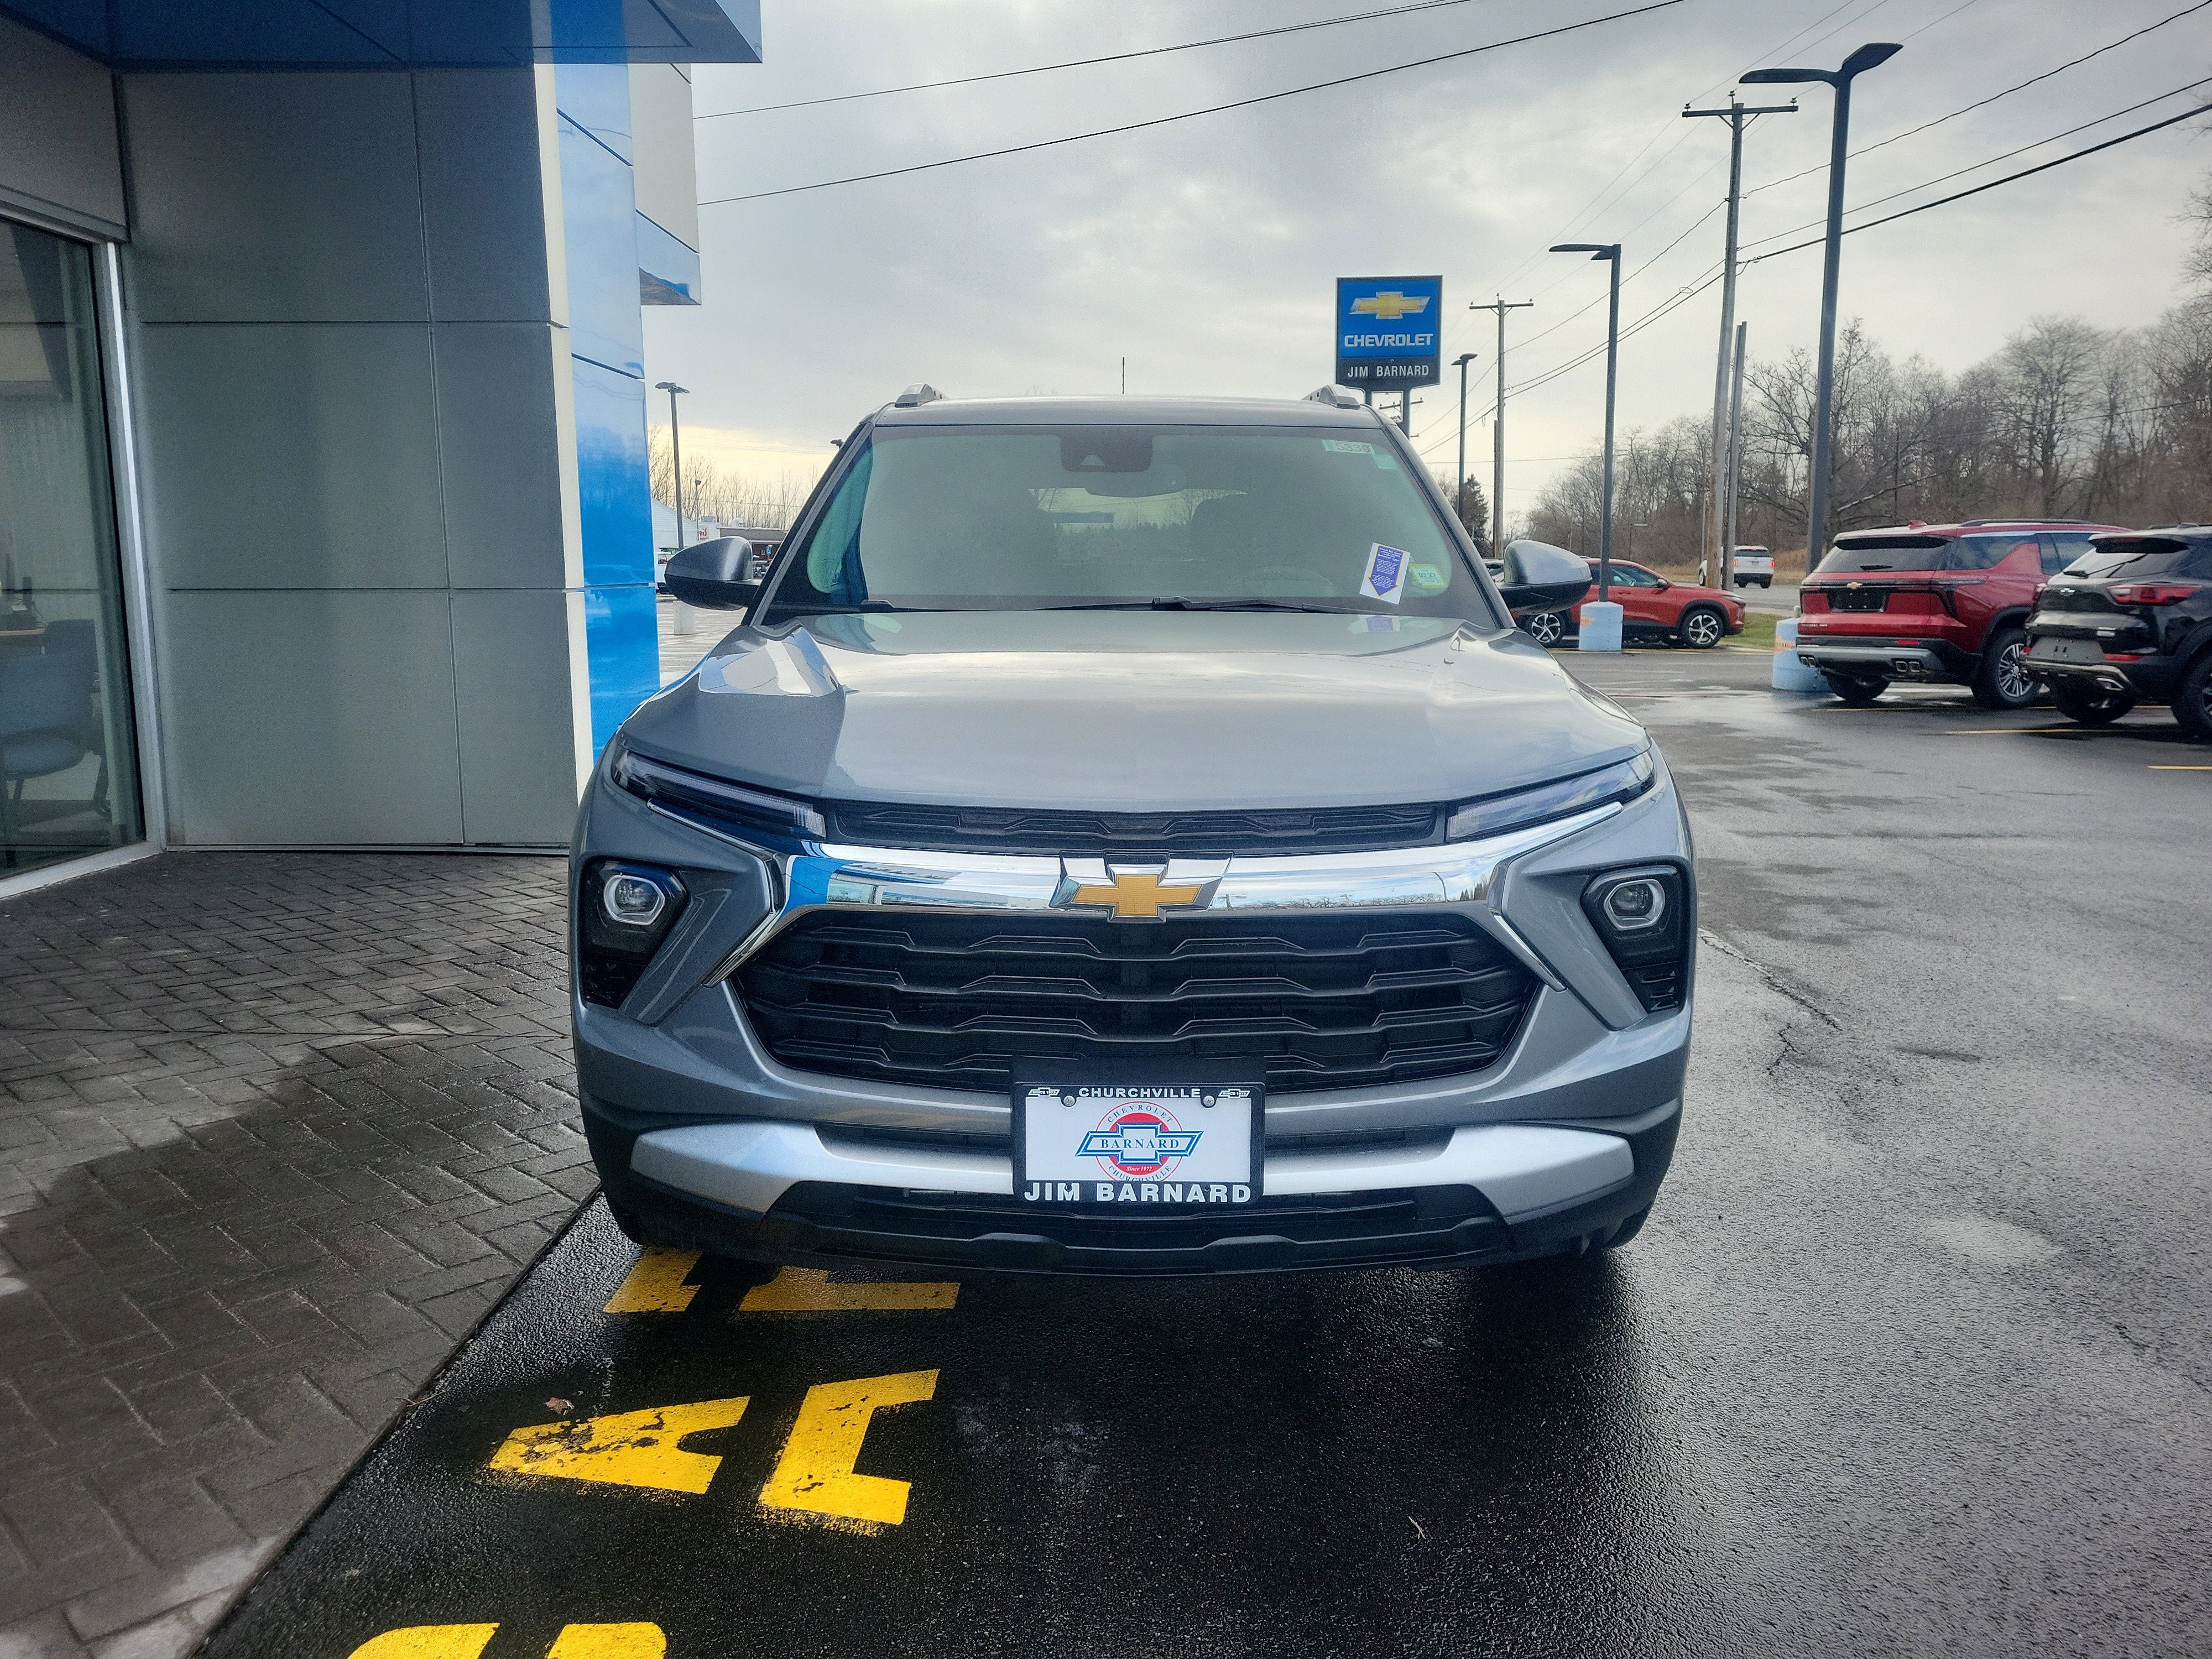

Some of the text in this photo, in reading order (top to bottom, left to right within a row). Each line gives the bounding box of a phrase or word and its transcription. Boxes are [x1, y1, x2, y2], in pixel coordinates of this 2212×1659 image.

[1344, 333, 1433, 347] CHEVROLET
[1348, 365, 1429, 377] JIM BARNARD
[1078, 1088, 1201, 1098] CHURCHVILLE
[1108, 1105, 1173, 1123] CHEVROLET
[1101, 1139, 1179, 1149] BARNARD
[1024, 1182, 1251, 1203] JIM BARNARD
